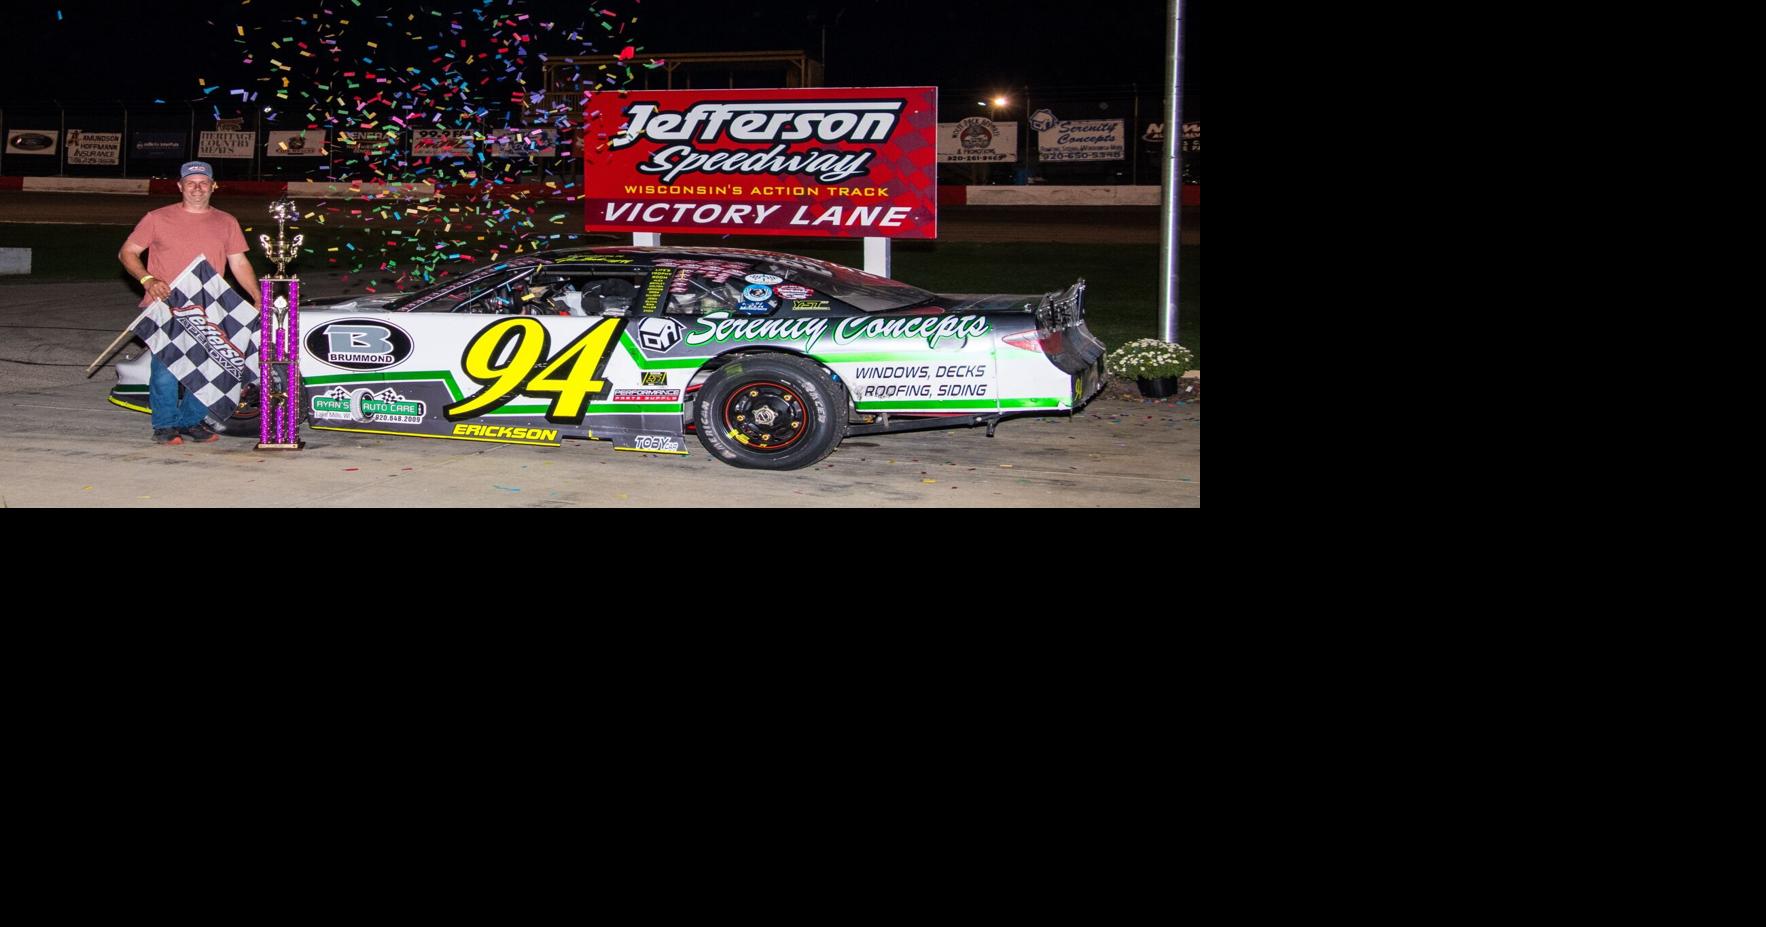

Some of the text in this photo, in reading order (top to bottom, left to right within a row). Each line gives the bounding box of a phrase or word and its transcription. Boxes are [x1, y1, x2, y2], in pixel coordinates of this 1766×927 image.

[613, 101, 902, 148] Jefferson
[1058, 121, 1118, 133] Serenity
[201, 132, 253, 140] HERITAGE
[1057, 133, 1116, 144] Concepts
[640, 144, 869, 183] Speedway
[625, 184, 889, 197] WISCONSIN'S ACTION TRACK
[602, 202, 912, 227] VICTORY LANE
[172, 304, 246, 371] Jefferso
[323, 325, 395, 354] B
[685, 311, 994, 353] Serenity Concepts
[330, 354, 393, 363] BRUMMOND
[445, 317, 627, 422] 94
[855, 365, 987, 380] WINDOWS, DECKS
[864, 384, 988, 398] ROOFING, SIDING
[316, 400, 350, 409] RYAN'S
[362, 402, 388, 412] AUTO
[390, 403, 415, 413] CARE
[453, 424, 558, 441] ERICKSON
[635, 435, 672, 449] TOBY
